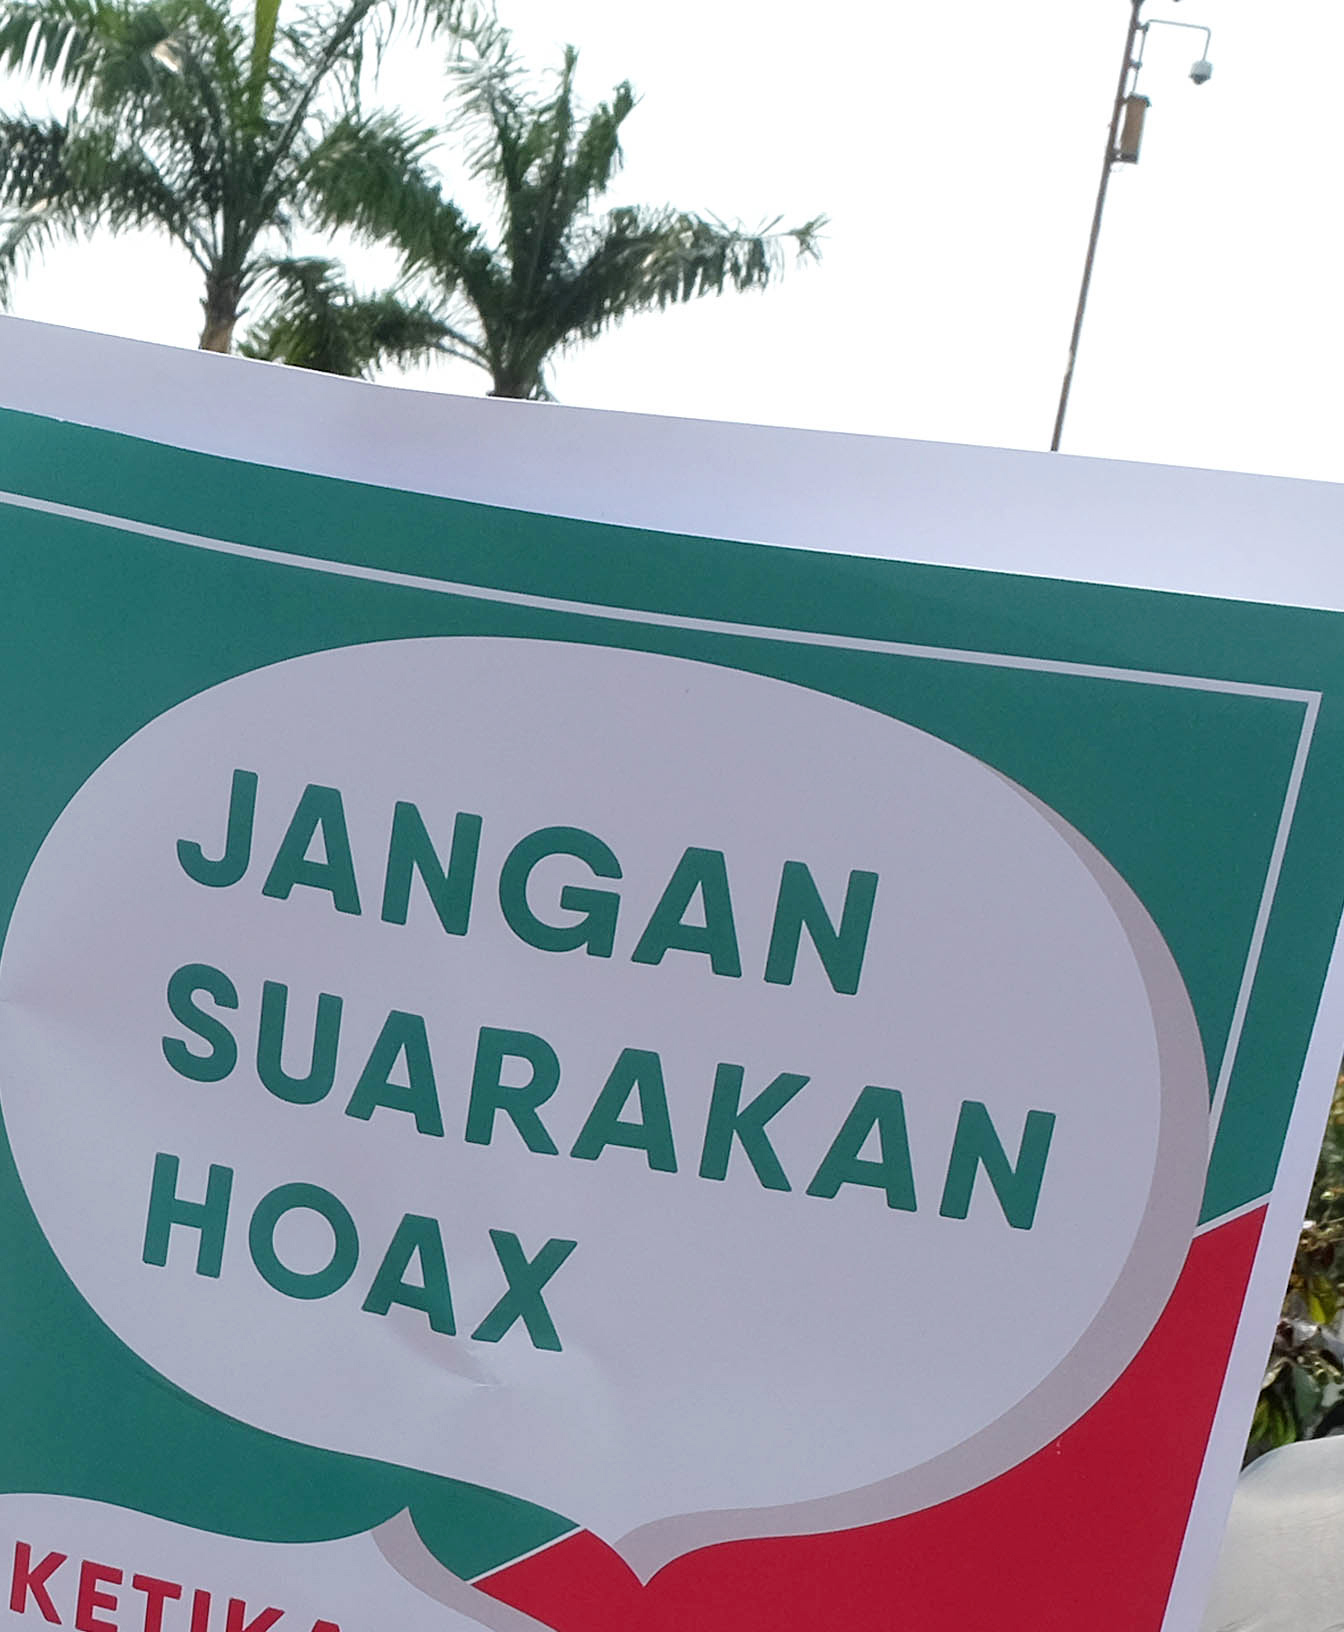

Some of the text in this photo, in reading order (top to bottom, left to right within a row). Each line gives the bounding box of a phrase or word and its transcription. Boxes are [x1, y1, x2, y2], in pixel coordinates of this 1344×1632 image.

[175, 769, 879, 996] JANGAN
[161, 963, 1057, 1231] SUARAKAN
[141, 1152, 579, 1352] HOAX
